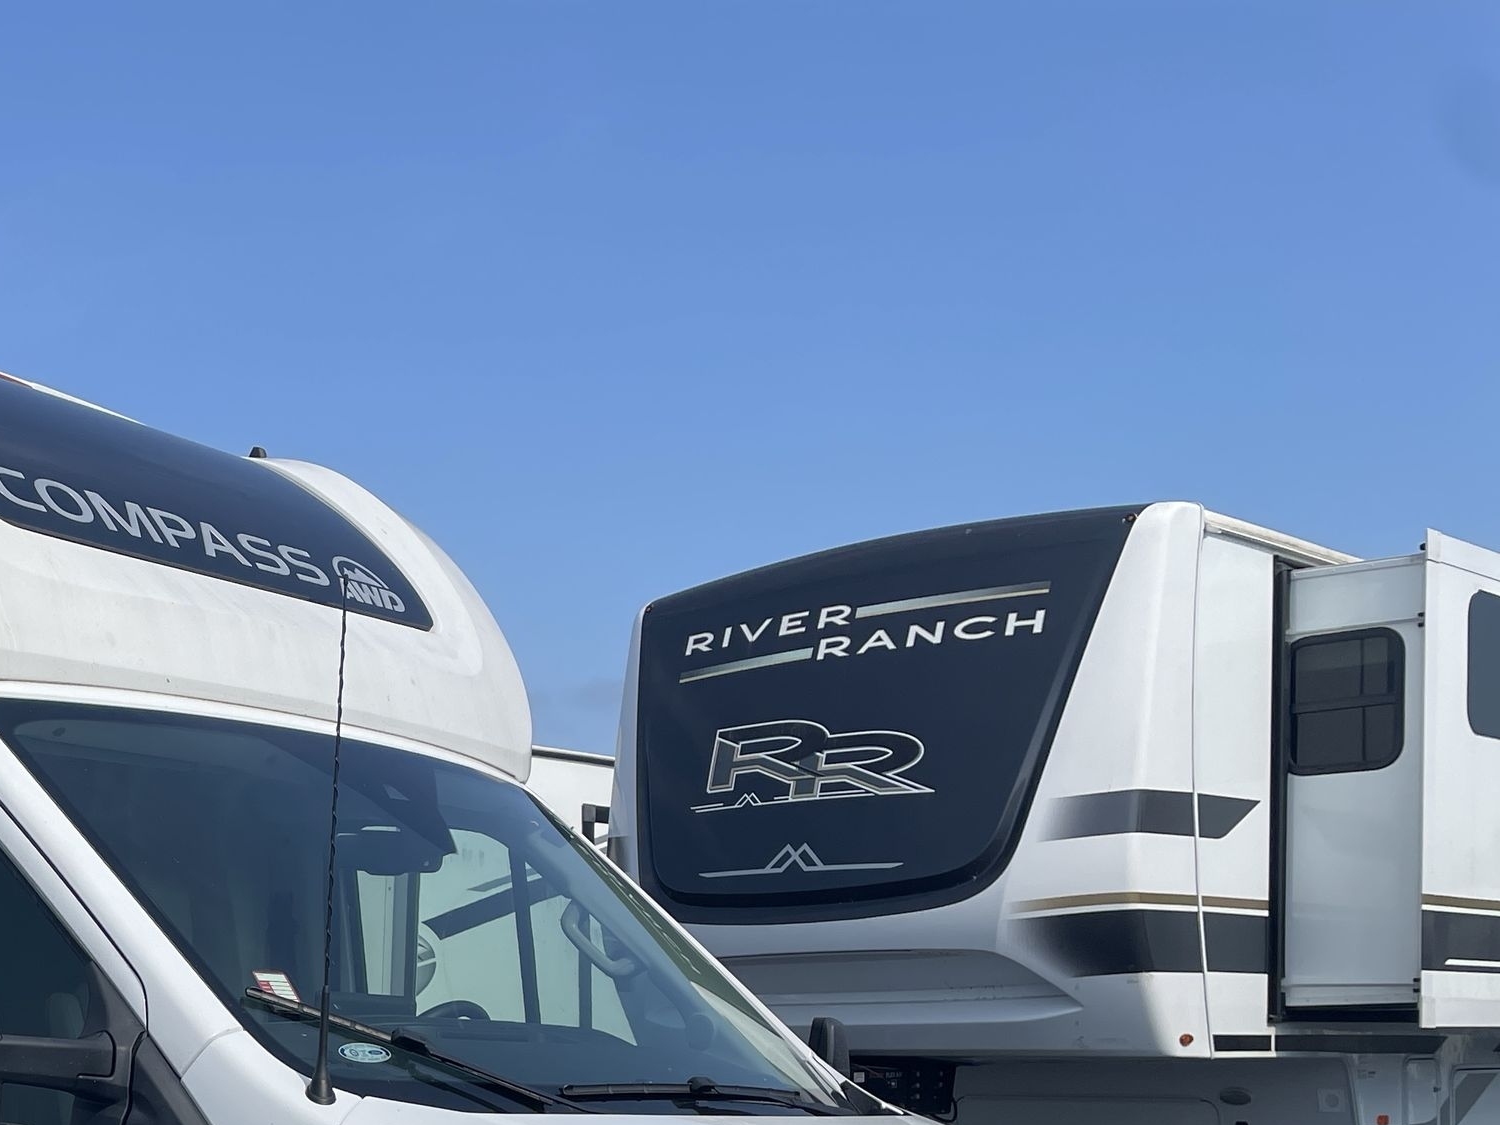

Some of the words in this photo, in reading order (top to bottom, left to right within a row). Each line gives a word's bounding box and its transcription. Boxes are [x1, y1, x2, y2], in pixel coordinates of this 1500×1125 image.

[339, 577, 406, 613] AWD
[684, 604, 853, 657] RIVER
[815, 609, 1047, 661] RANCH
[706, 719, 936, 799] RR
